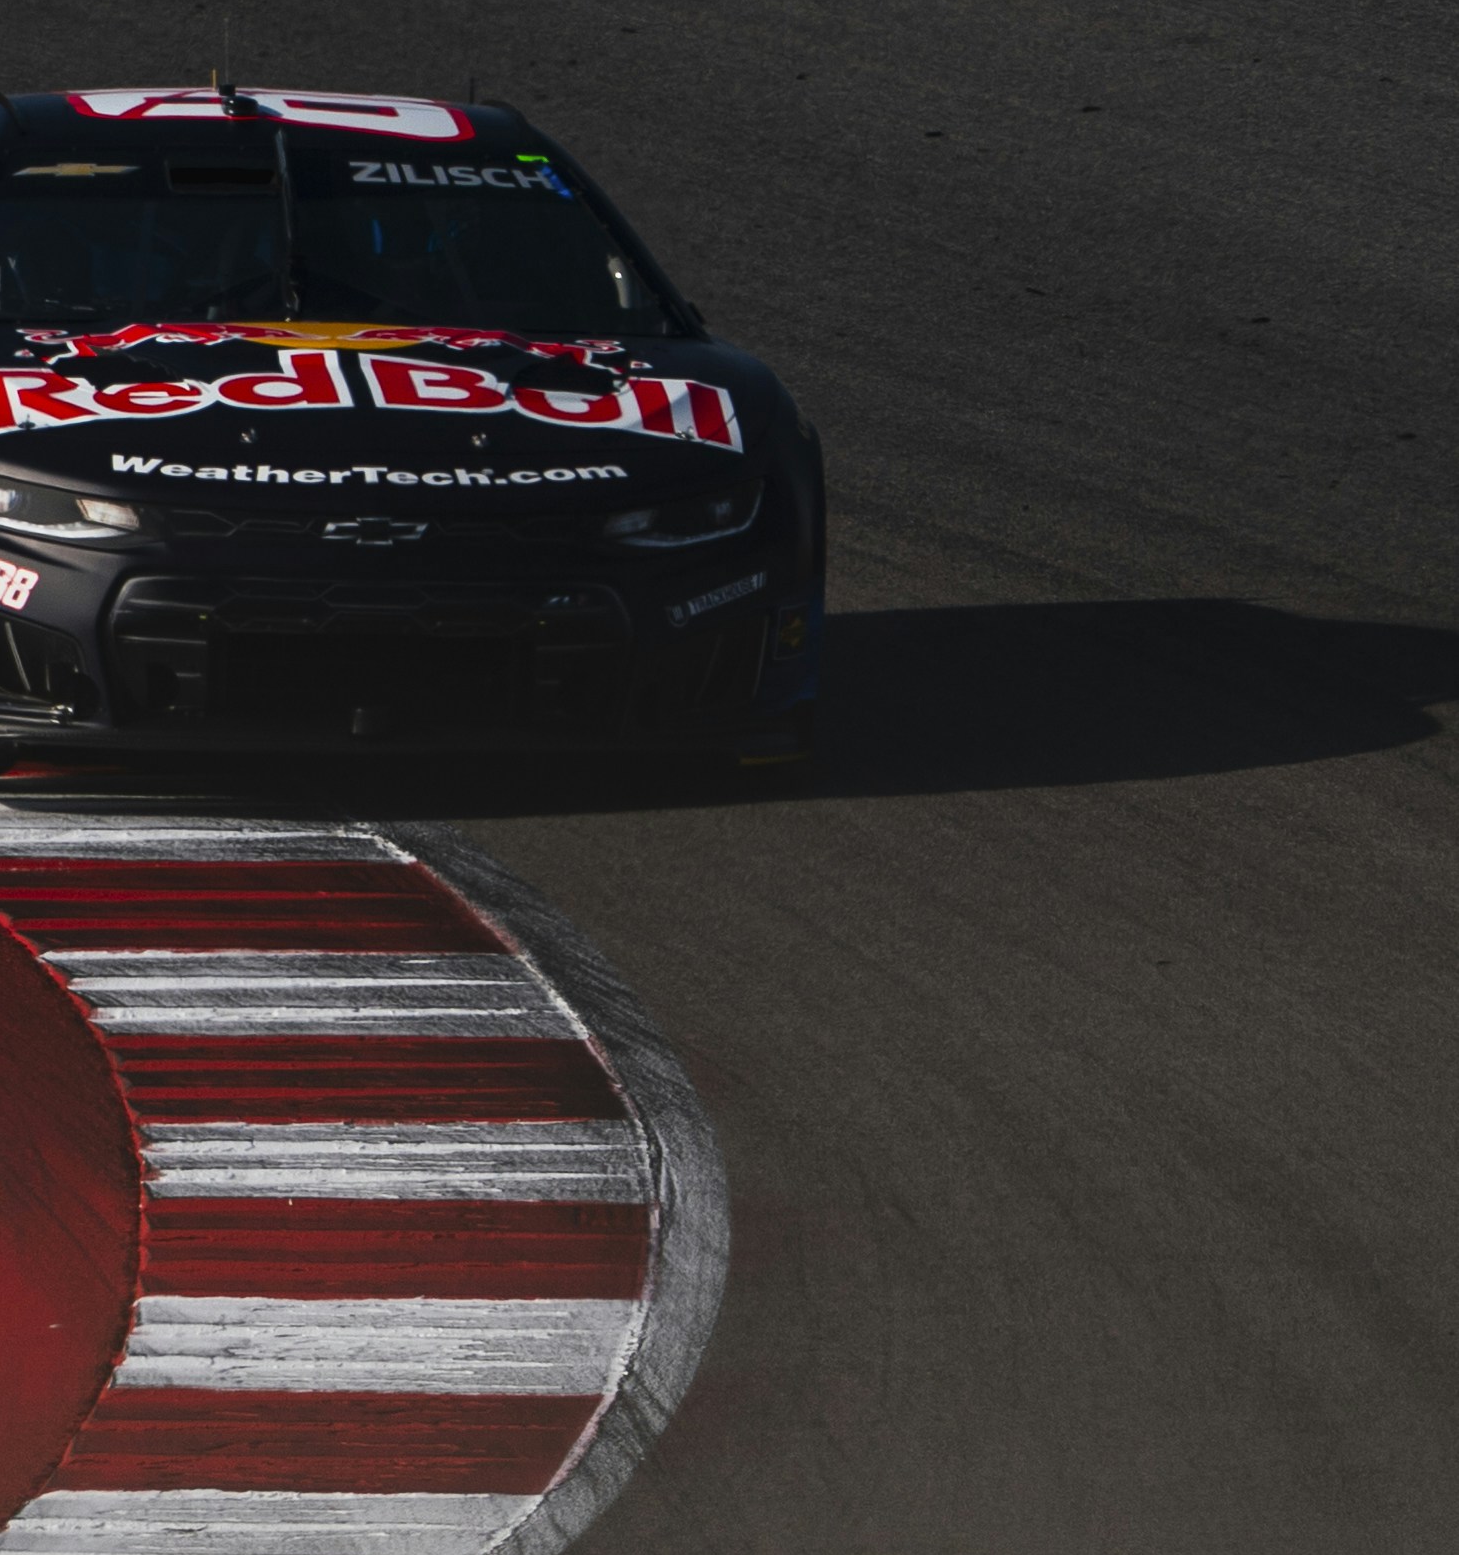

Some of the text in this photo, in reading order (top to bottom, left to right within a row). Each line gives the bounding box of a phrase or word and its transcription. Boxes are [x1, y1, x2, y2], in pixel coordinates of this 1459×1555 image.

[348, 160, 556, 190] ZILISCH
[357, 351, 744, 454] Bull
[110, 453, 629, 487] WeatherTech.com
